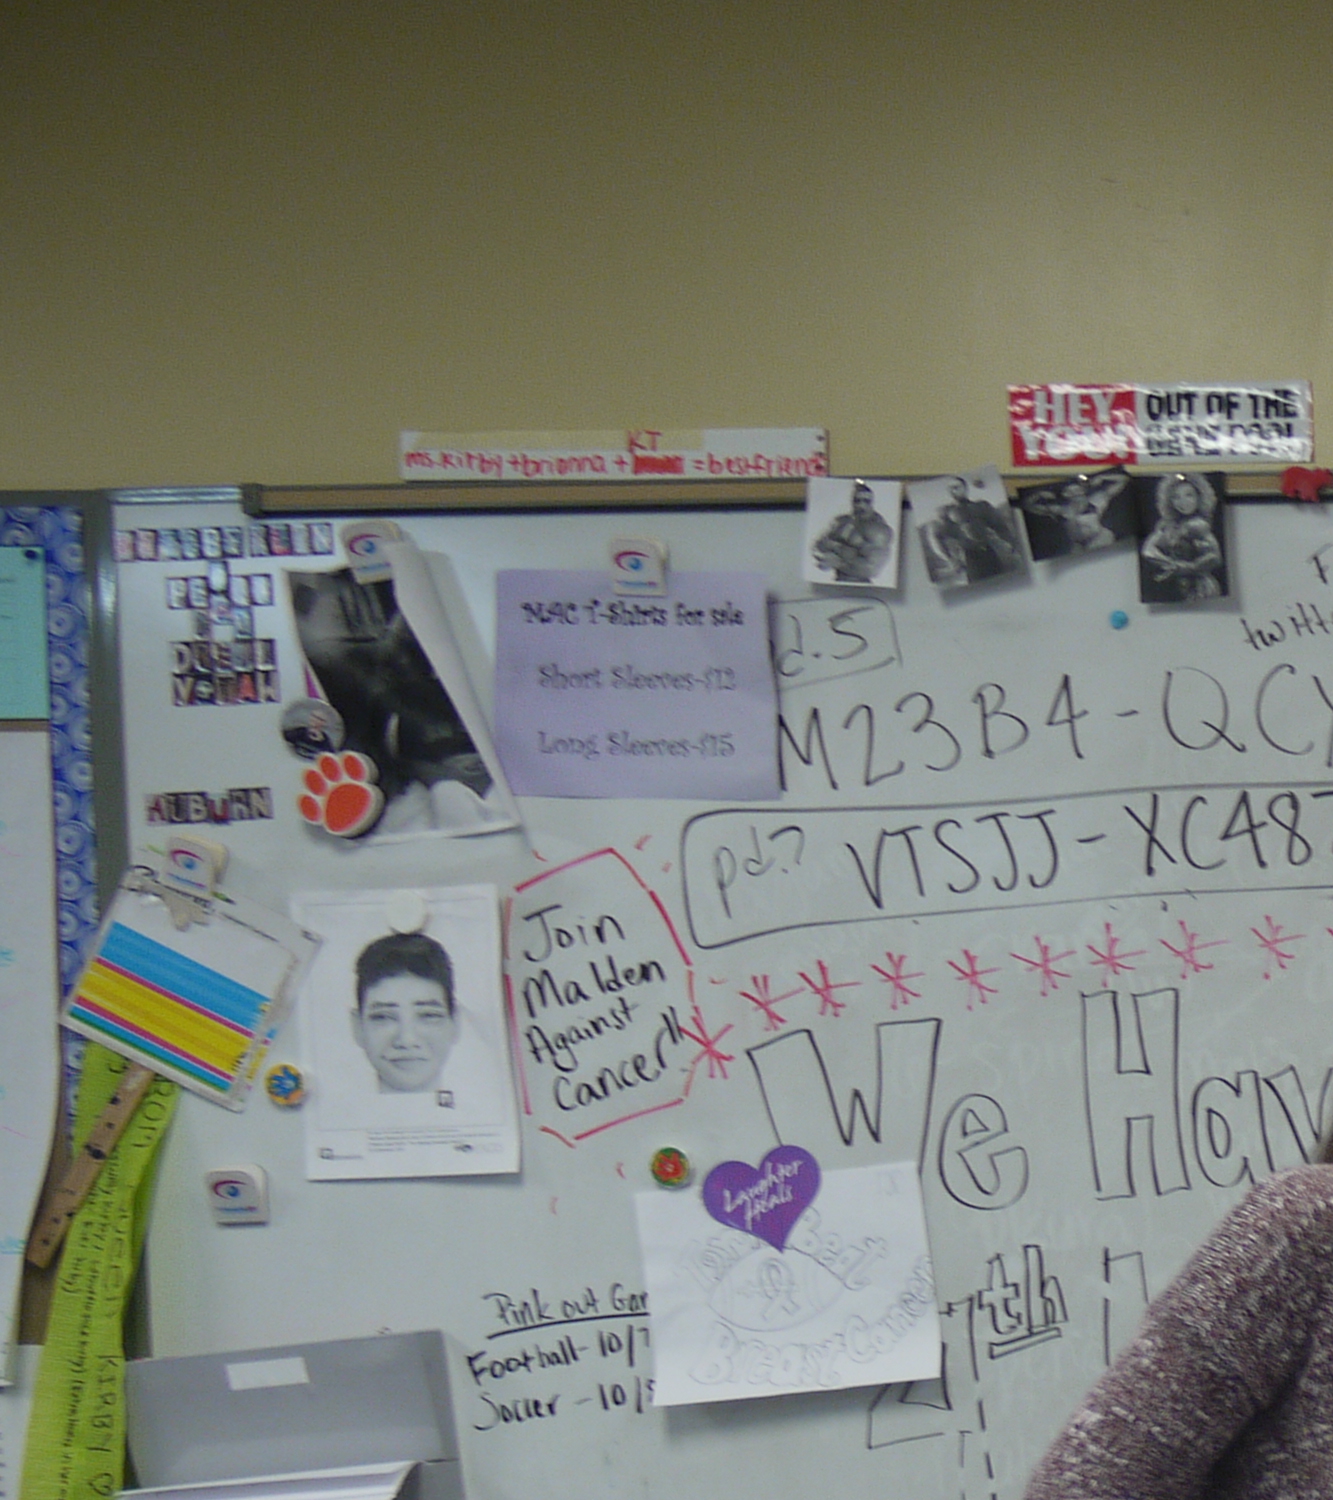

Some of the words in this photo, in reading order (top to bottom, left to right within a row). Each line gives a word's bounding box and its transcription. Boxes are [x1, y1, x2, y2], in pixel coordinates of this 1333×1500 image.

[1033, 388, 1119, 426] HEY
[1145, 389, 1200, 422] OUT
[1205, 388, 1243, 420] OF
[1248, 385, 1299, 420] THE
[538, 662, 604, 691] Short
[537, 730, 600, 761] Long
[146, 788, 274, 825] AUBURN
[523, 904, 626, 963] Join
[521, 957, 668, 1018] Malden
[526, 1001, 638, 1072] Against
[746, 1017, 1030, 1212] We
[482, 1288, 556, 1327] Pink
[561, 1286, 602, 1319] out
